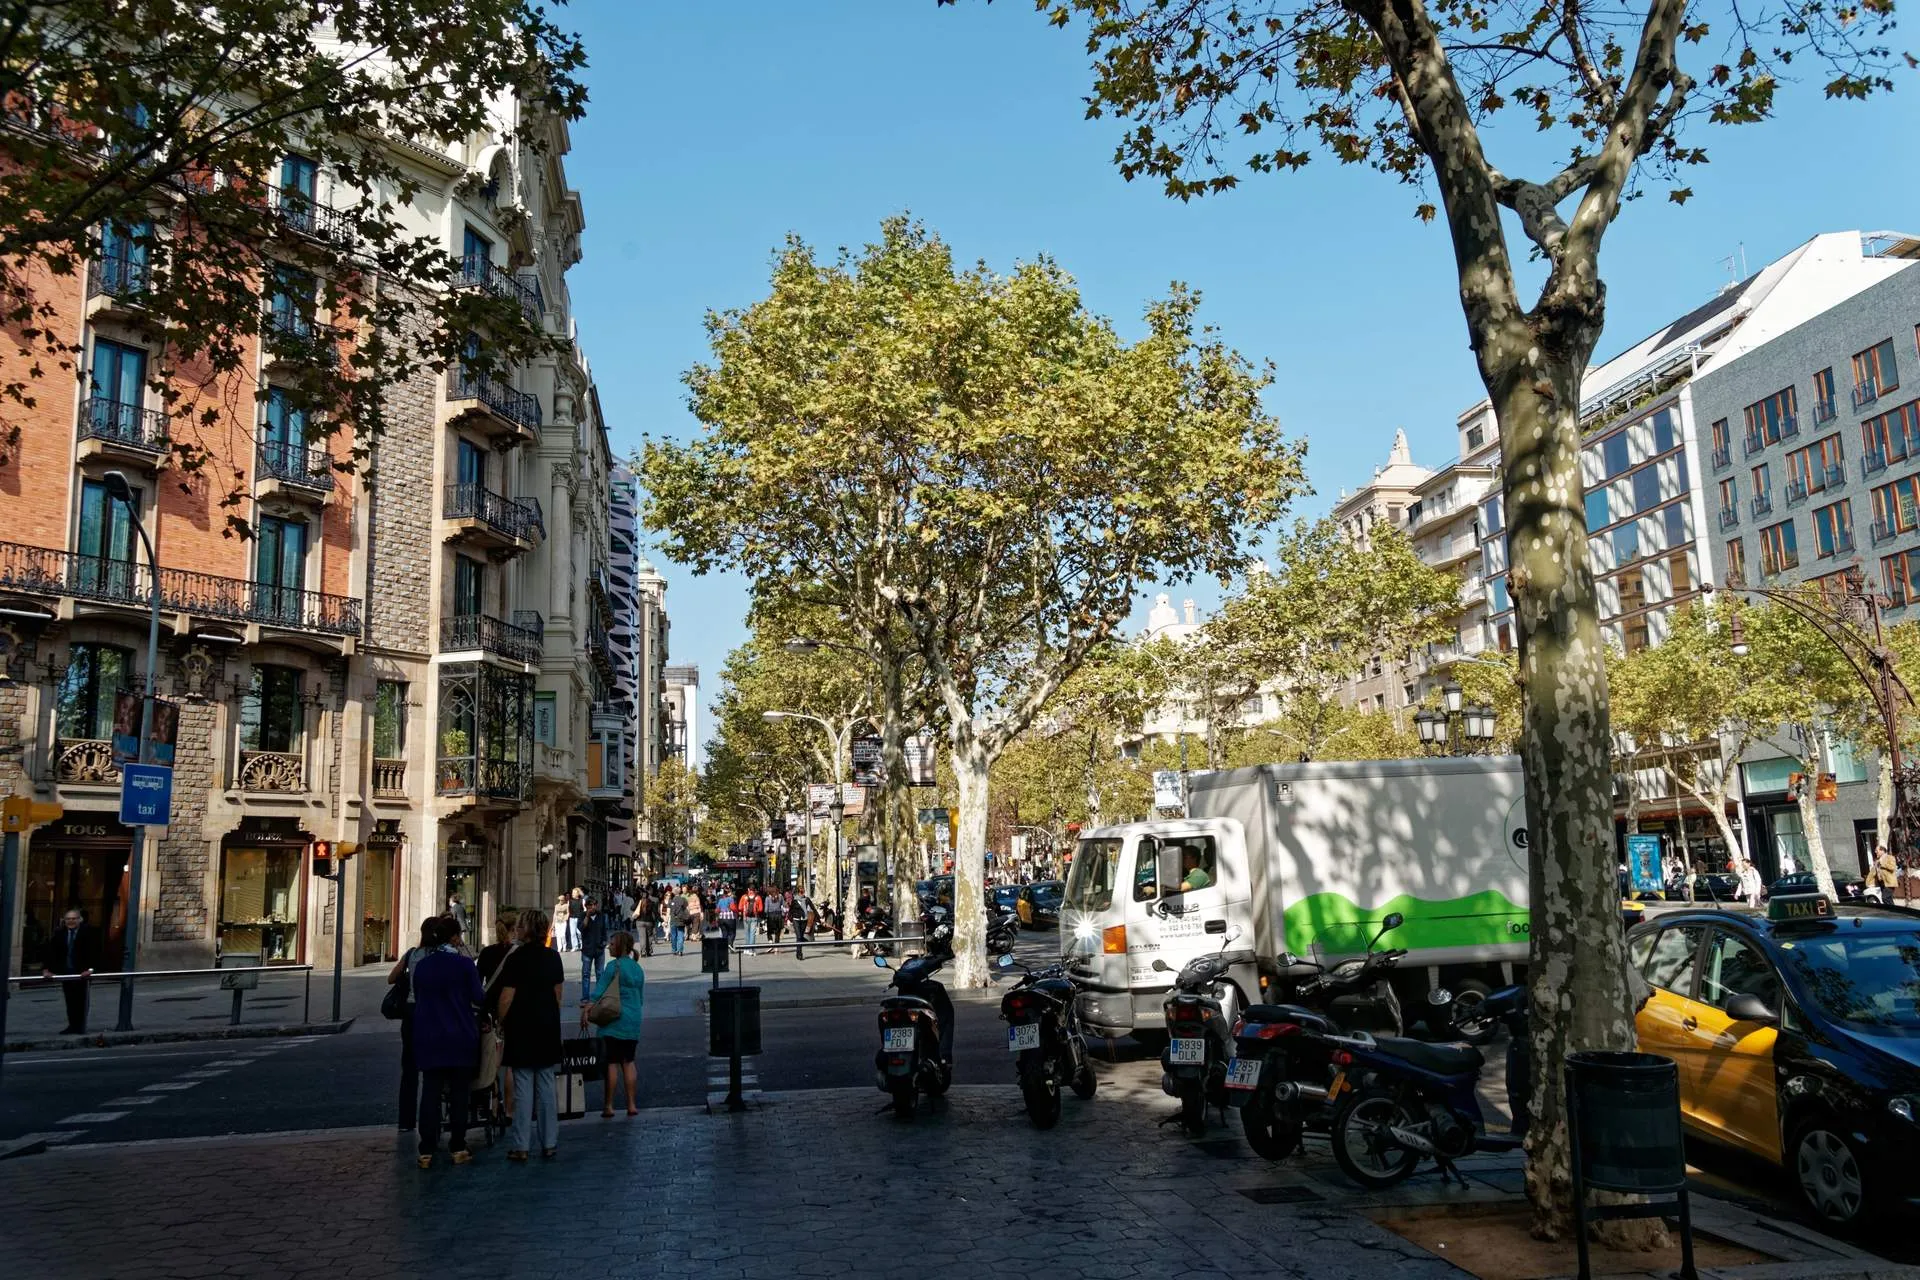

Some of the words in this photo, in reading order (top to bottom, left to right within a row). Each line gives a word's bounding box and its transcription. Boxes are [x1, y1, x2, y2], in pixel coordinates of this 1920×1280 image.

[138, 804, 156, 815] taxi
[63, 824, 107, 836] TOUS
[1785, 902, 1814, 916] TAXI
[892, 1029, 913, 1038] 2383
[1016, 1025, 1037, 1036] 3073
[891, 1039, 907, 1048] FDJ
[1019, 1035, 1035, 1046] GJK
[1179, 1040, 1202, 1050] 6839
[1178, 1051, 1197, 1060] DLR
[1235, 1061, 1259, 1072] 2851
